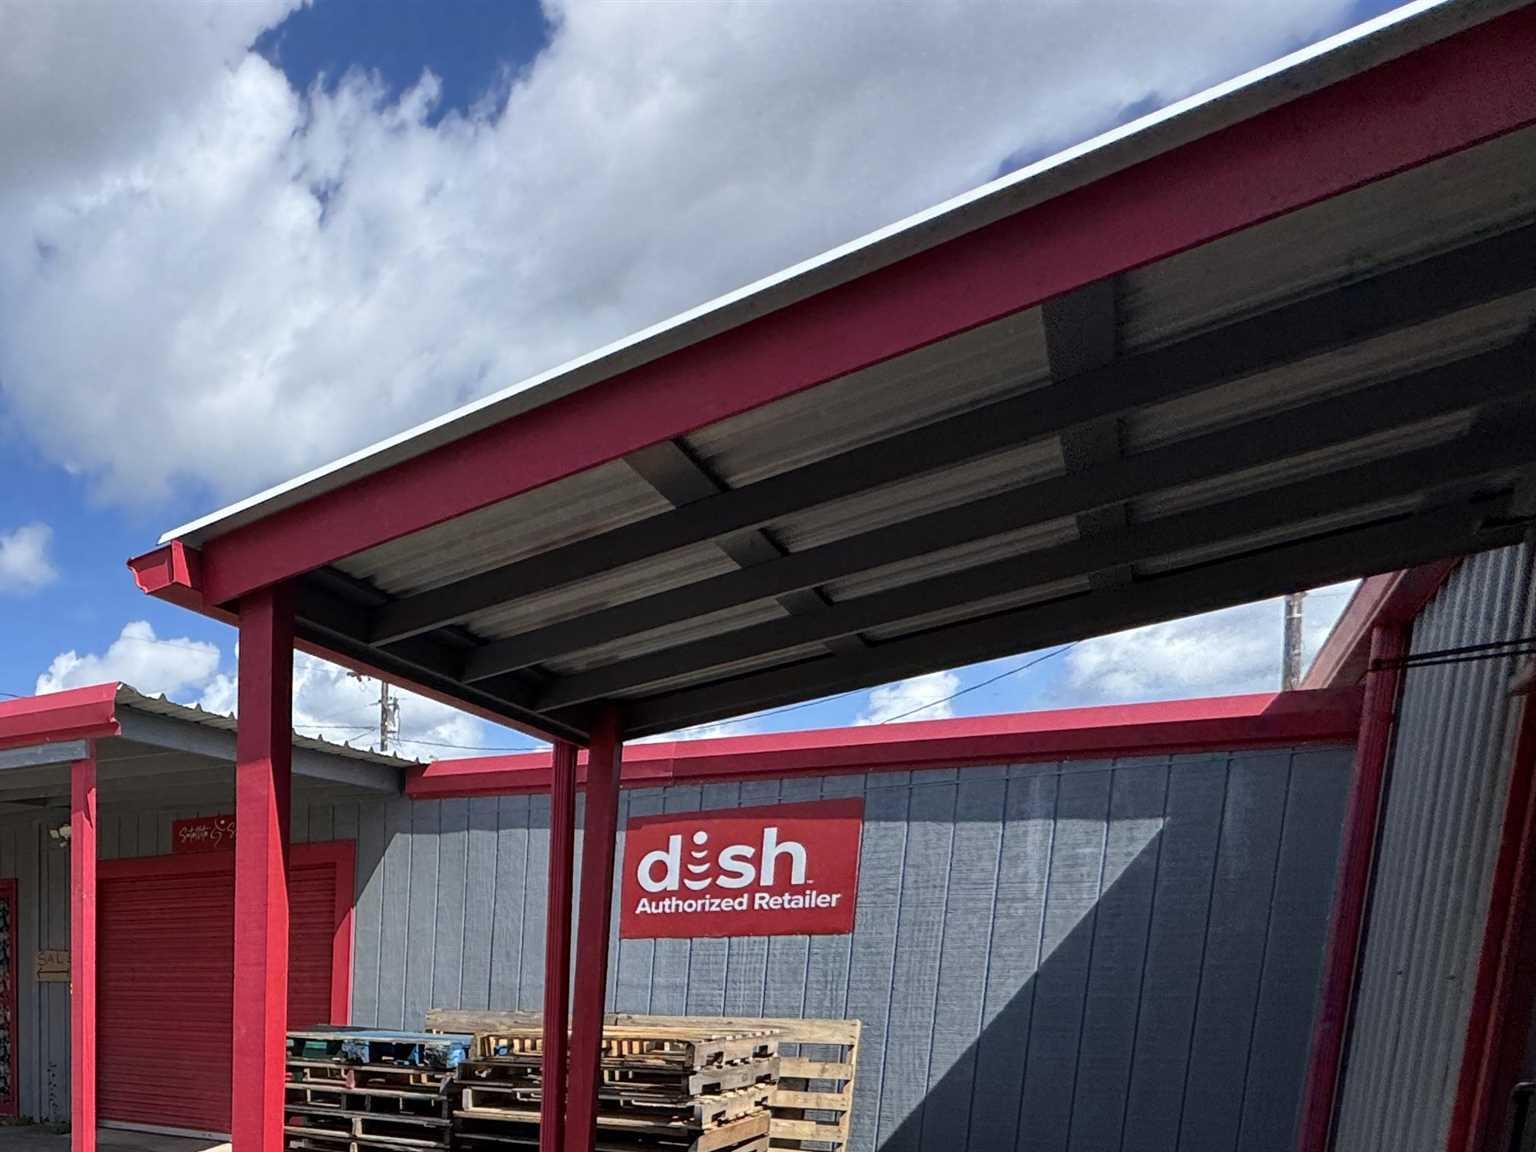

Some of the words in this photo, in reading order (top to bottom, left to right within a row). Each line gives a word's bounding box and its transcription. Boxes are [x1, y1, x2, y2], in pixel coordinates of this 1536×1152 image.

[636, 827, 807, 893] dish
[634, 892, 749, 915] Authorized
[753, 889, 842, 911] Retailer
